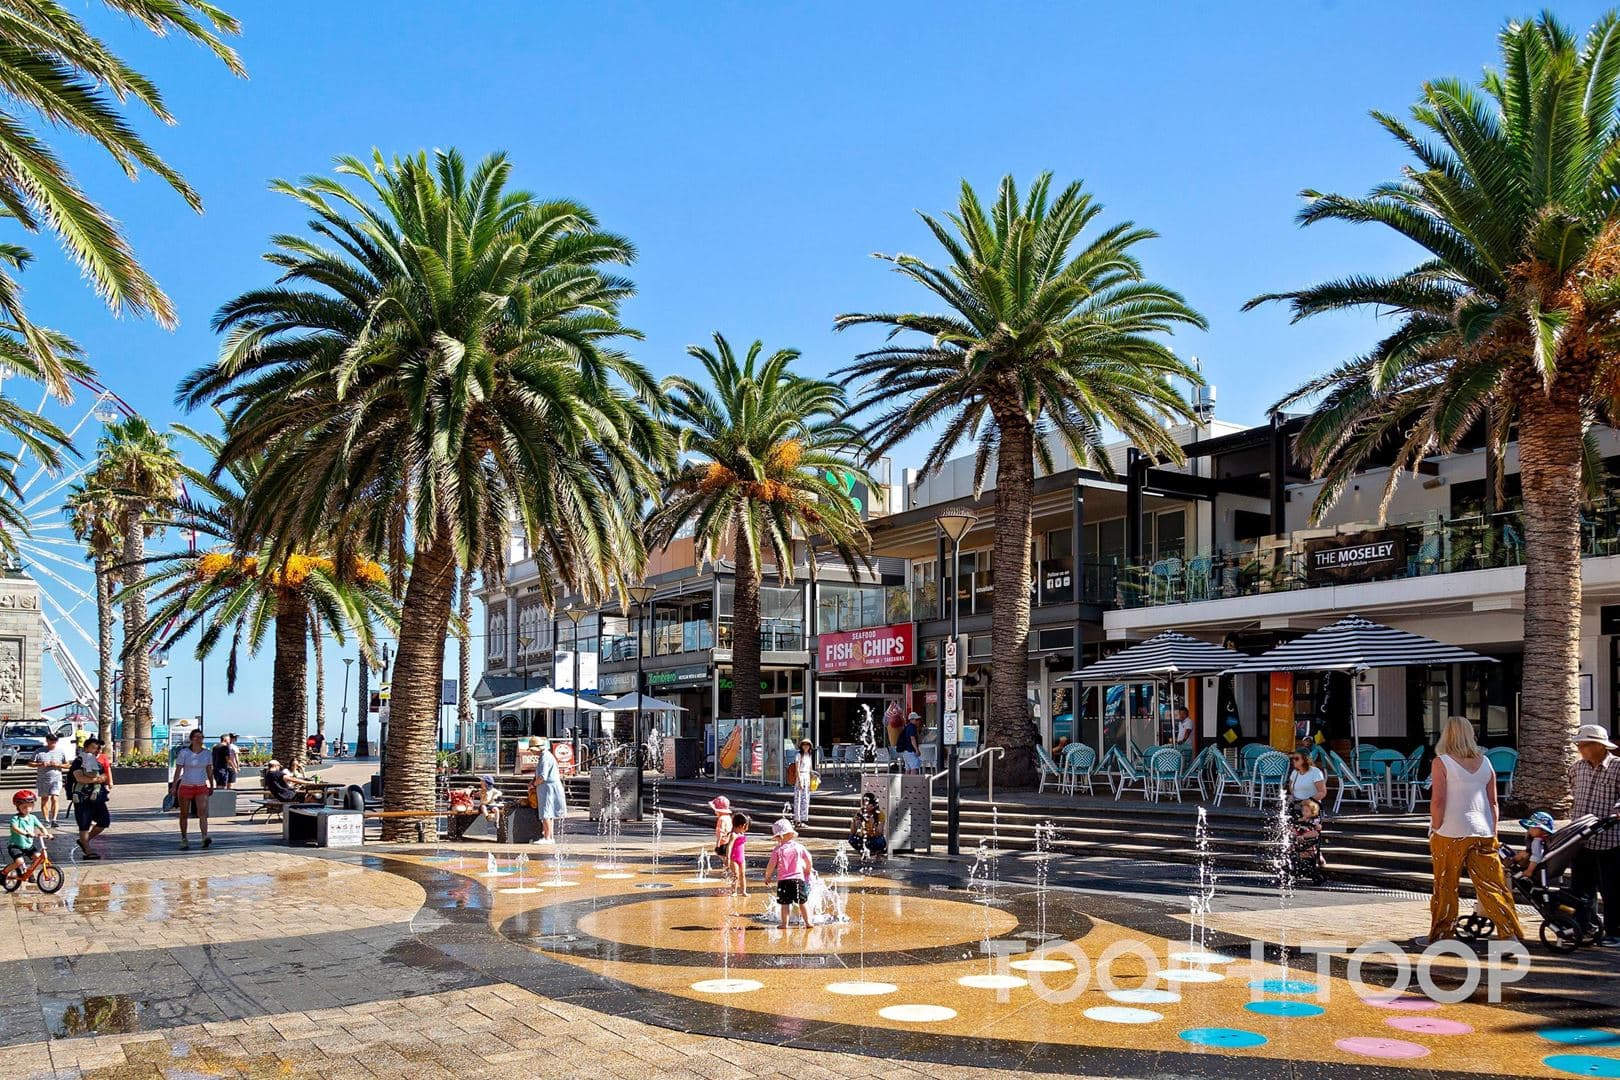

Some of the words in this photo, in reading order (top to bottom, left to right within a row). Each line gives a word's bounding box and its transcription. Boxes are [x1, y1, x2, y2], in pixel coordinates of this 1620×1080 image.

[1315, 551, 1336, 565] THE
[1338, 544, 1394, 562] MOSELEY
[852, 630, 876, 640] SEAFOOD
[826, 642, 853, 661] FISH
[863, 636, 904, 656] CHIPS
